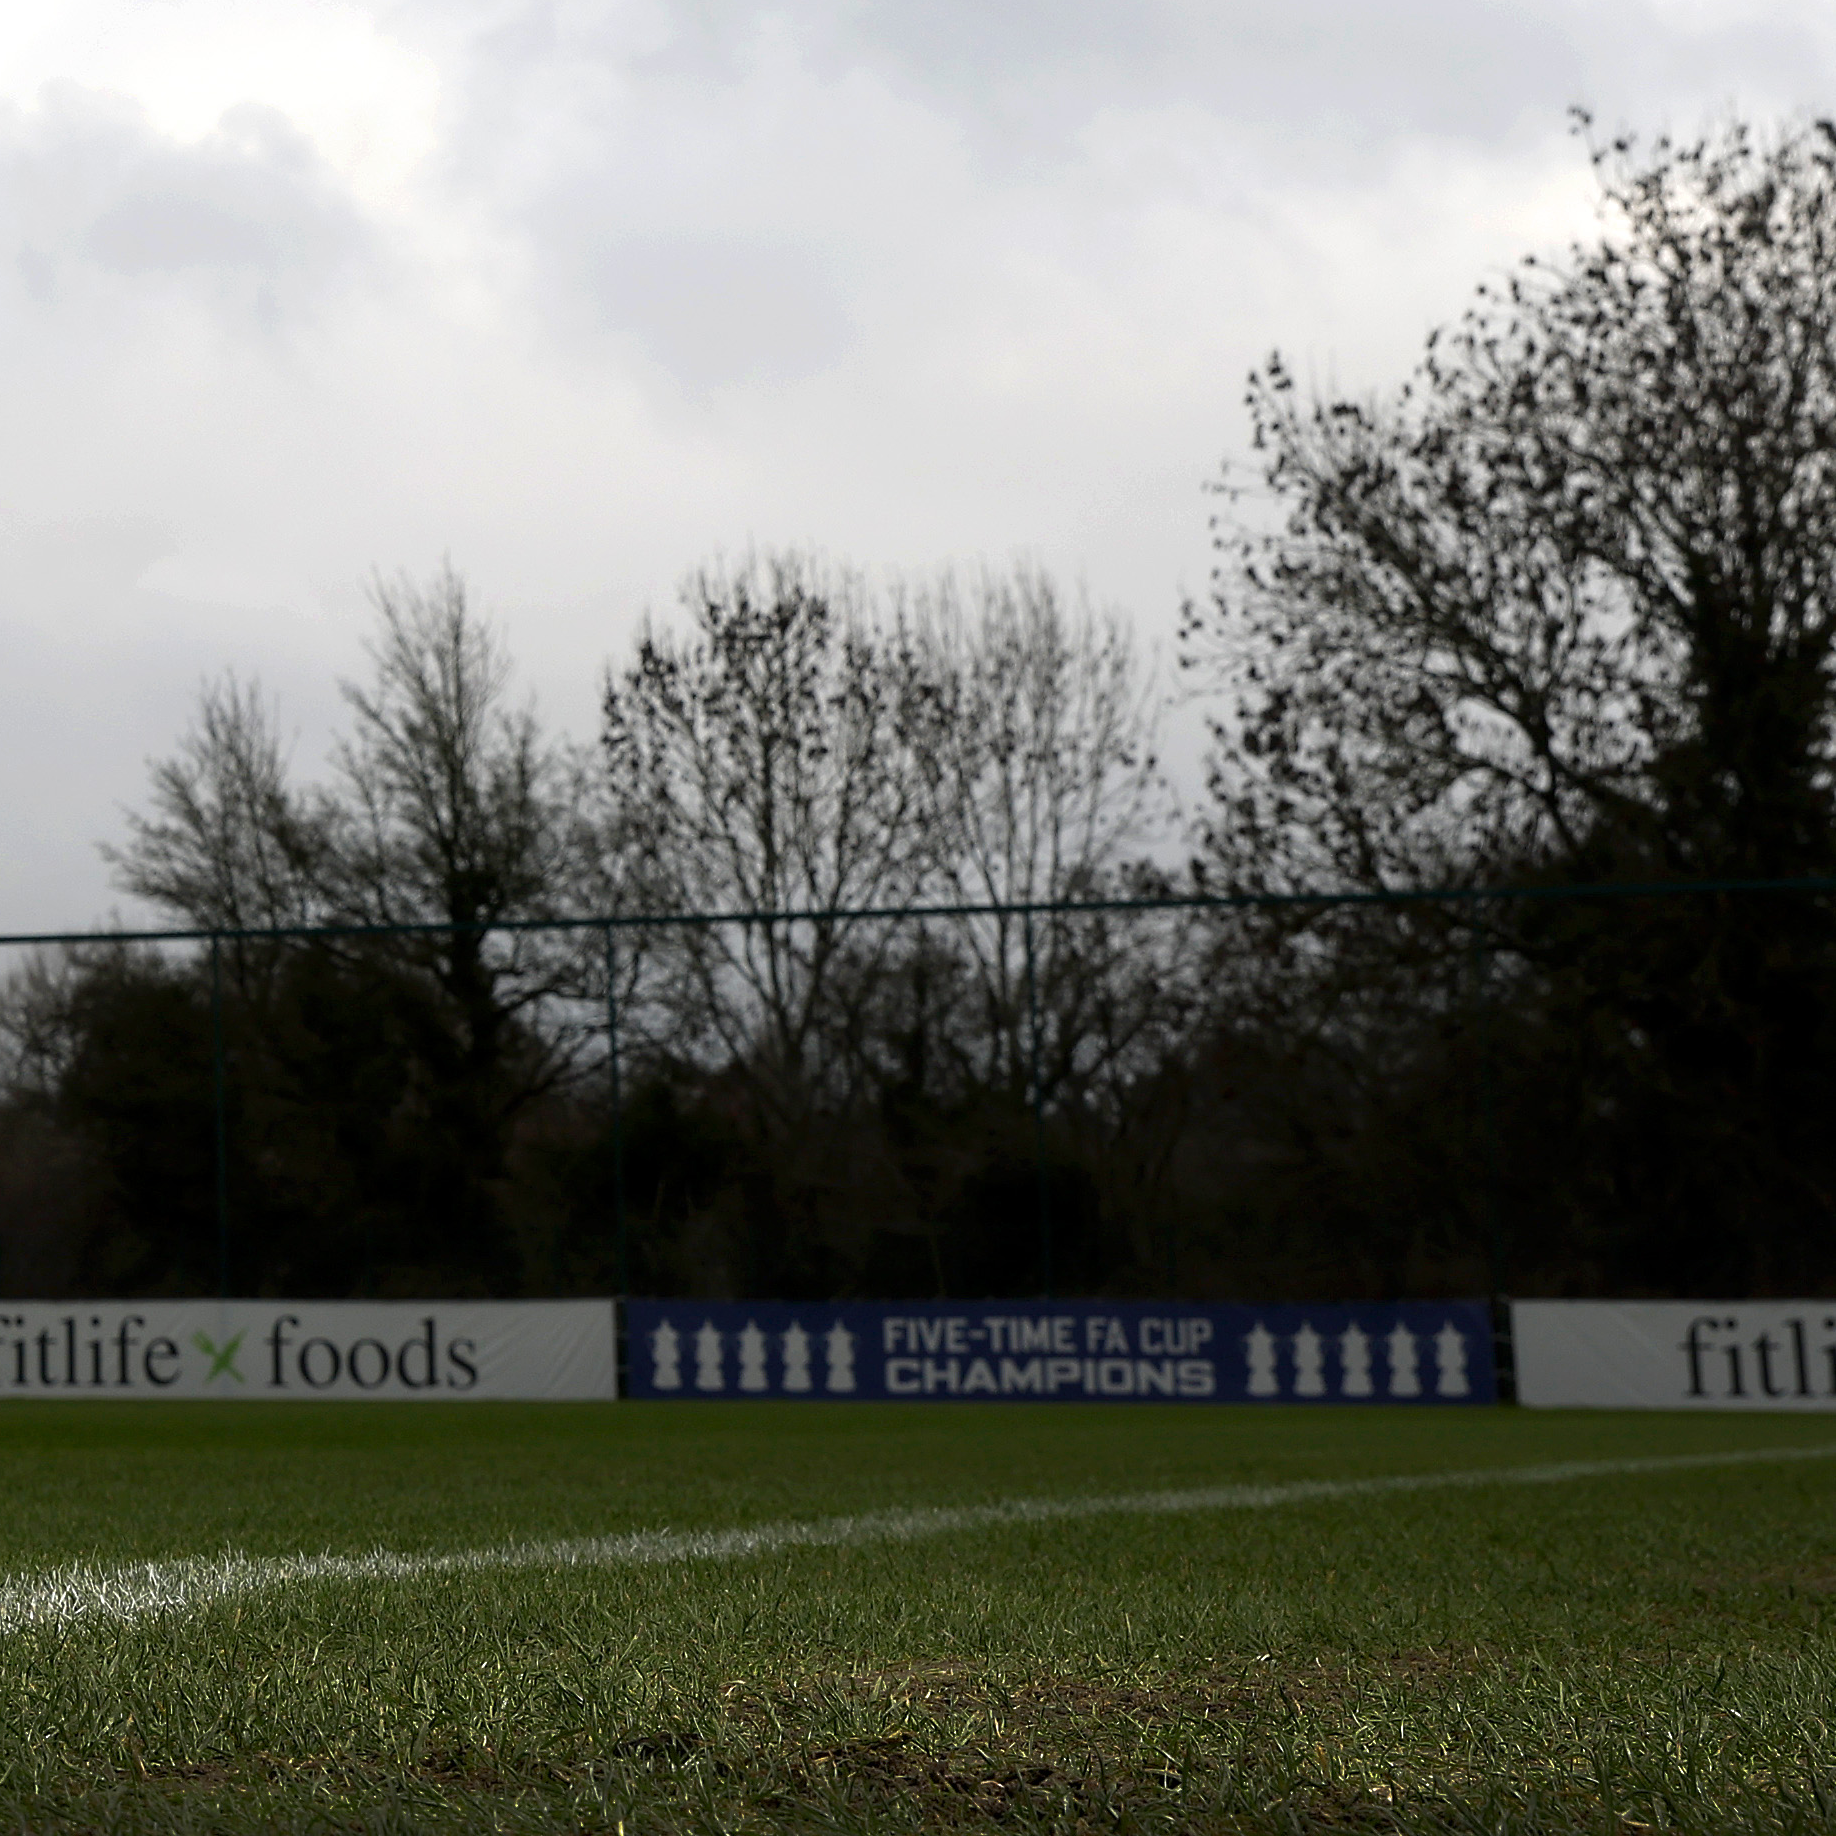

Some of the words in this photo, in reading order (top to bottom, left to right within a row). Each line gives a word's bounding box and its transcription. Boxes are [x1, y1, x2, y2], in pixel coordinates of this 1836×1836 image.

[265, 1315, 480, 1390] foods
[882, 1317, 1076, 1355] FIVE-TIME
[1086, 1317, 1128, 1355] FA
[1139, 1318, 1214, 1356] CUP
[885, 1357, 1216, 1396] CHAMPIONS
